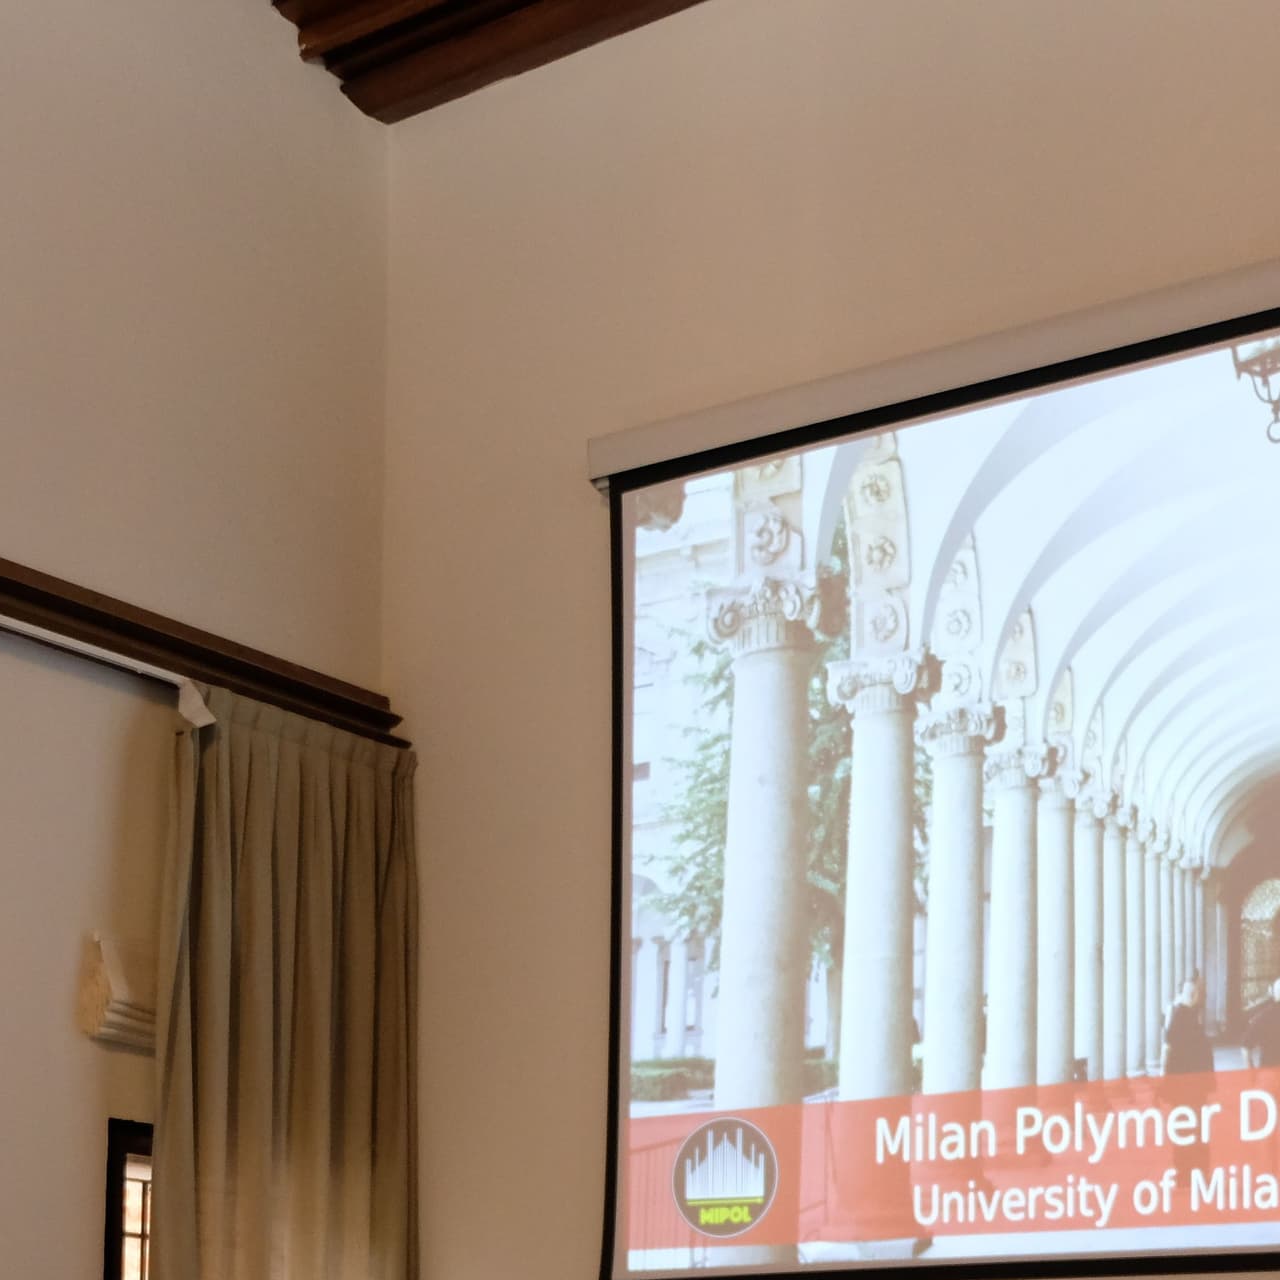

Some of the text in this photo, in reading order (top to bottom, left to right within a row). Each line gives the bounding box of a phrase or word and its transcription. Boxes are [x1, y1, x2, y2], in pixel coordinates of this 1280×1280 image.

[875, 1112, 997, 1165] Milan
[1015, 1100, 1222, 1164] Polymer
[698, 1205, 752, 1226] MIPOL
[912, 1174, 1119, 1228] University
[1132, 1168, 1177, 1214] of
